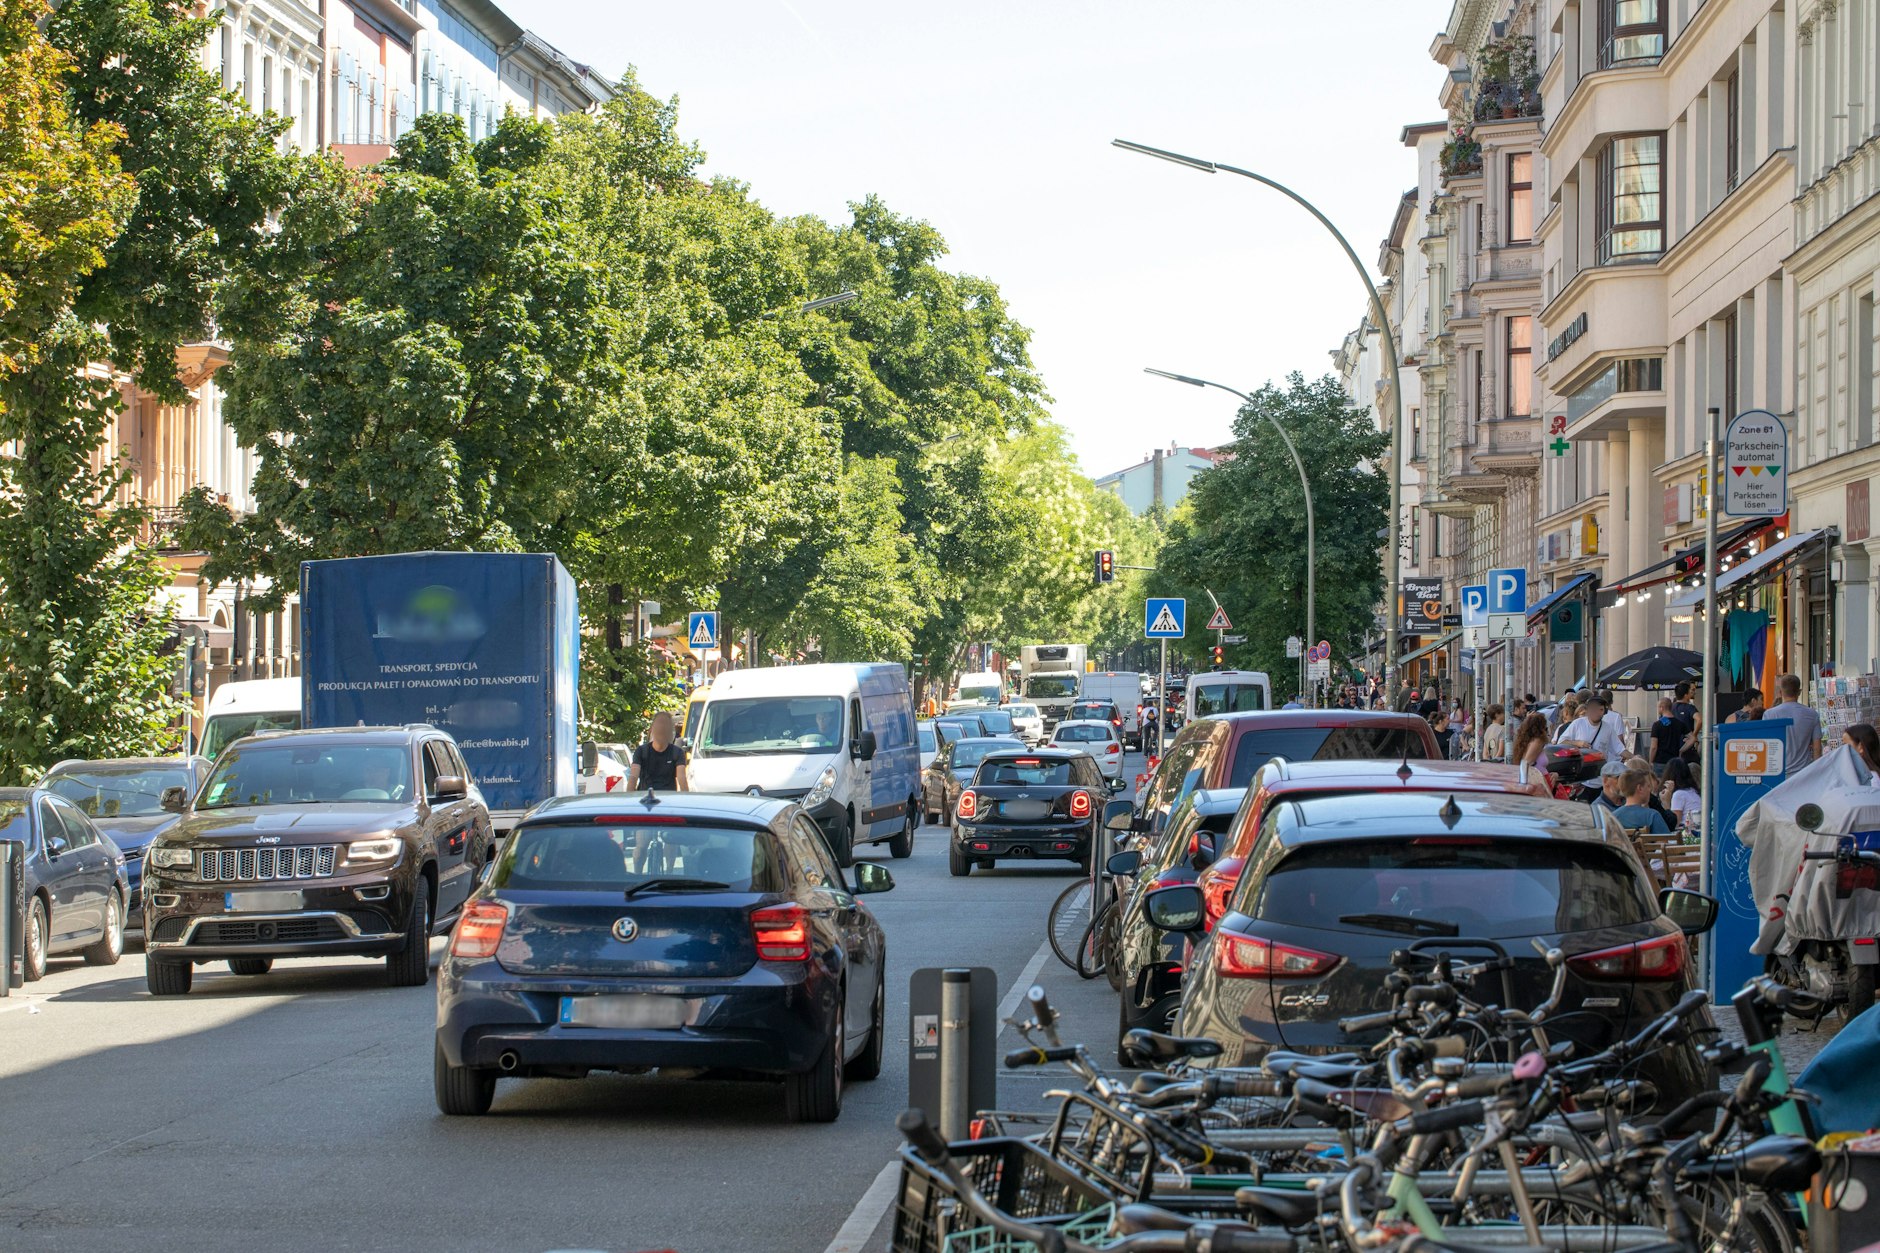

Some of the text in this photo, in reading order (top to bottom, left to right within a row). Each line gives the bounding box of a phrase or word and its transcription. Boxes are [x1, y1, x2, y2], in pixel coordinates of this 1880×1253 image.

[1739, 426, 1773, 434] Zone 61
[1729, 442, 1783, 450] Parkschein-
[1405, 583, 1442, 594] Brezel
[1497, 574, 1518, 608] P
[1416, 591, 1440, 599] Bar
[1467, 591, 1482, 621] P
[379, 662, 478, 673] TRANSPORT, SPEDYCJA
[318, 675, 540, 691] PRODUKCJA PALET I OPAKOWAŃ DO TRANSPORTU
[425, 705, 440, 713] tel.
[426, 717, 439, 725] fax
[457, 737, 530, 749] office@bwabis.pl
[483, 775, 521, 784] ładunek...
[255, 835, 281, 845] Jeep
[1281, 994, 1330, 1006] CX-3
